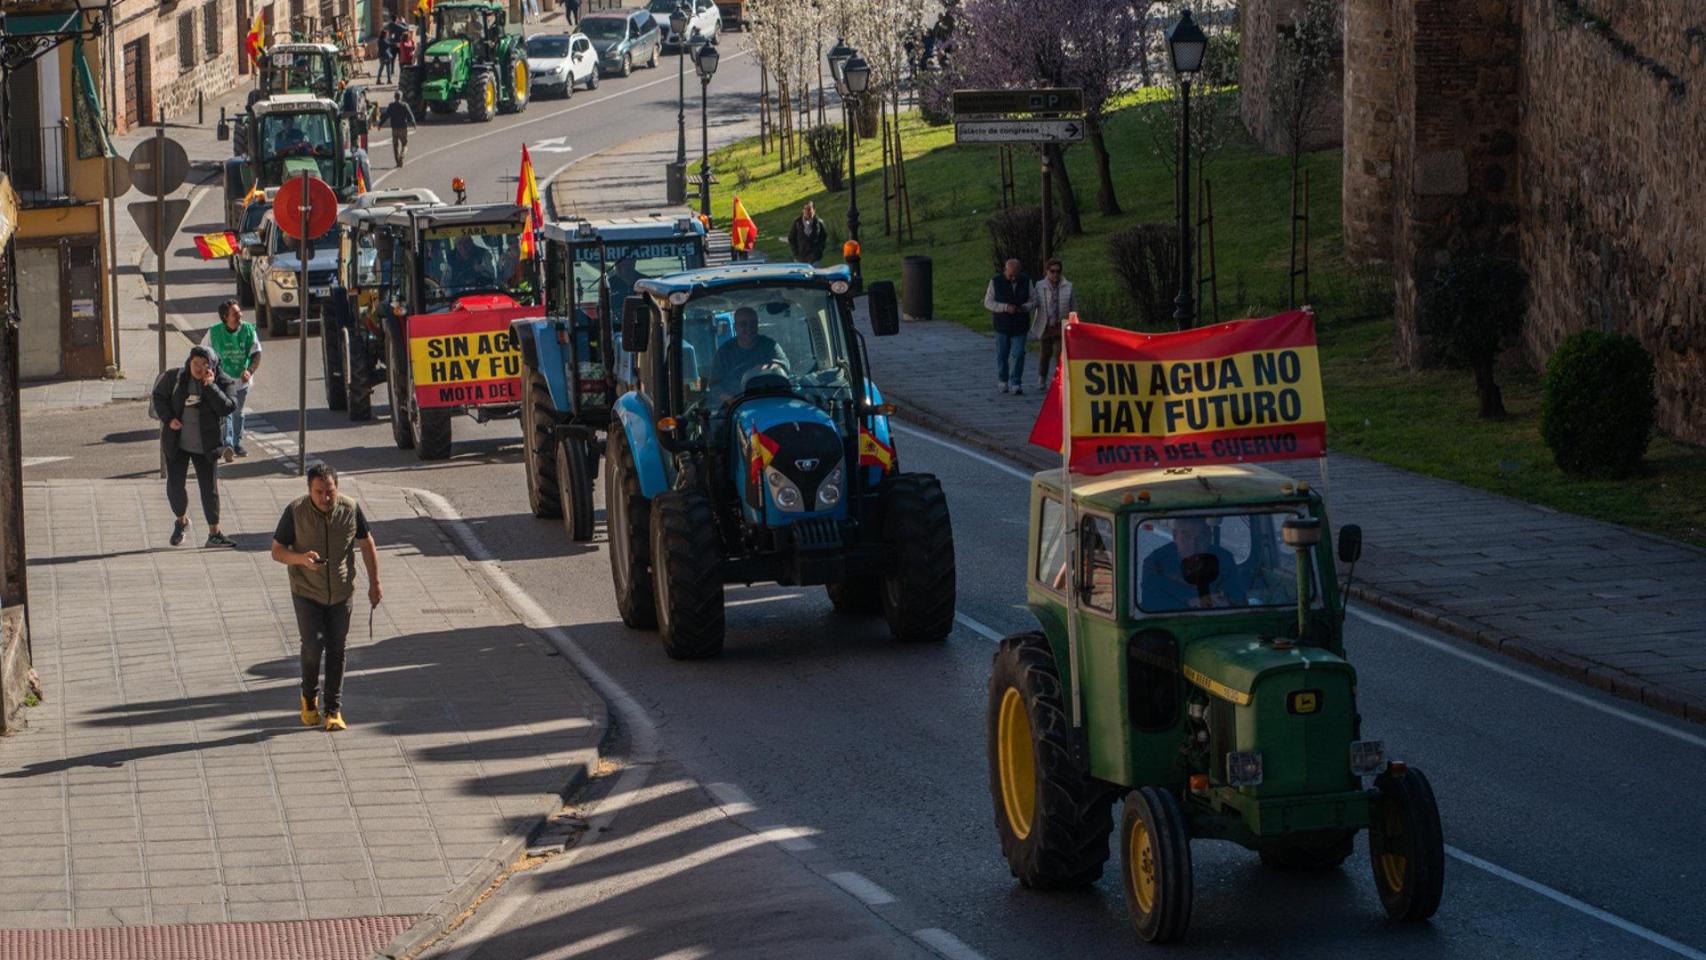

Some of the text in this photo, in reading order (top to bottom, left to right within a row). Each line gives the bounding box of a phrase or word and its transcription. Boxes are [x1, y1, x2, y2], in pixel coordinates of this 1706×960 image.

[988, 127, 998, 136] de
[575, 246, 600, 261] LOS
[427, 335, 469, 359] SIN
[430, 358, 480, 383] HAY
[1084, 350, 1301, 396] SIN AGUA NO
[440, 382, 516, 403] MOTA DEL
[1090, 388, 1301, 433] HAY FUTURO
[1096, 432, 1298, 465] MOTA DEL CUERVO
